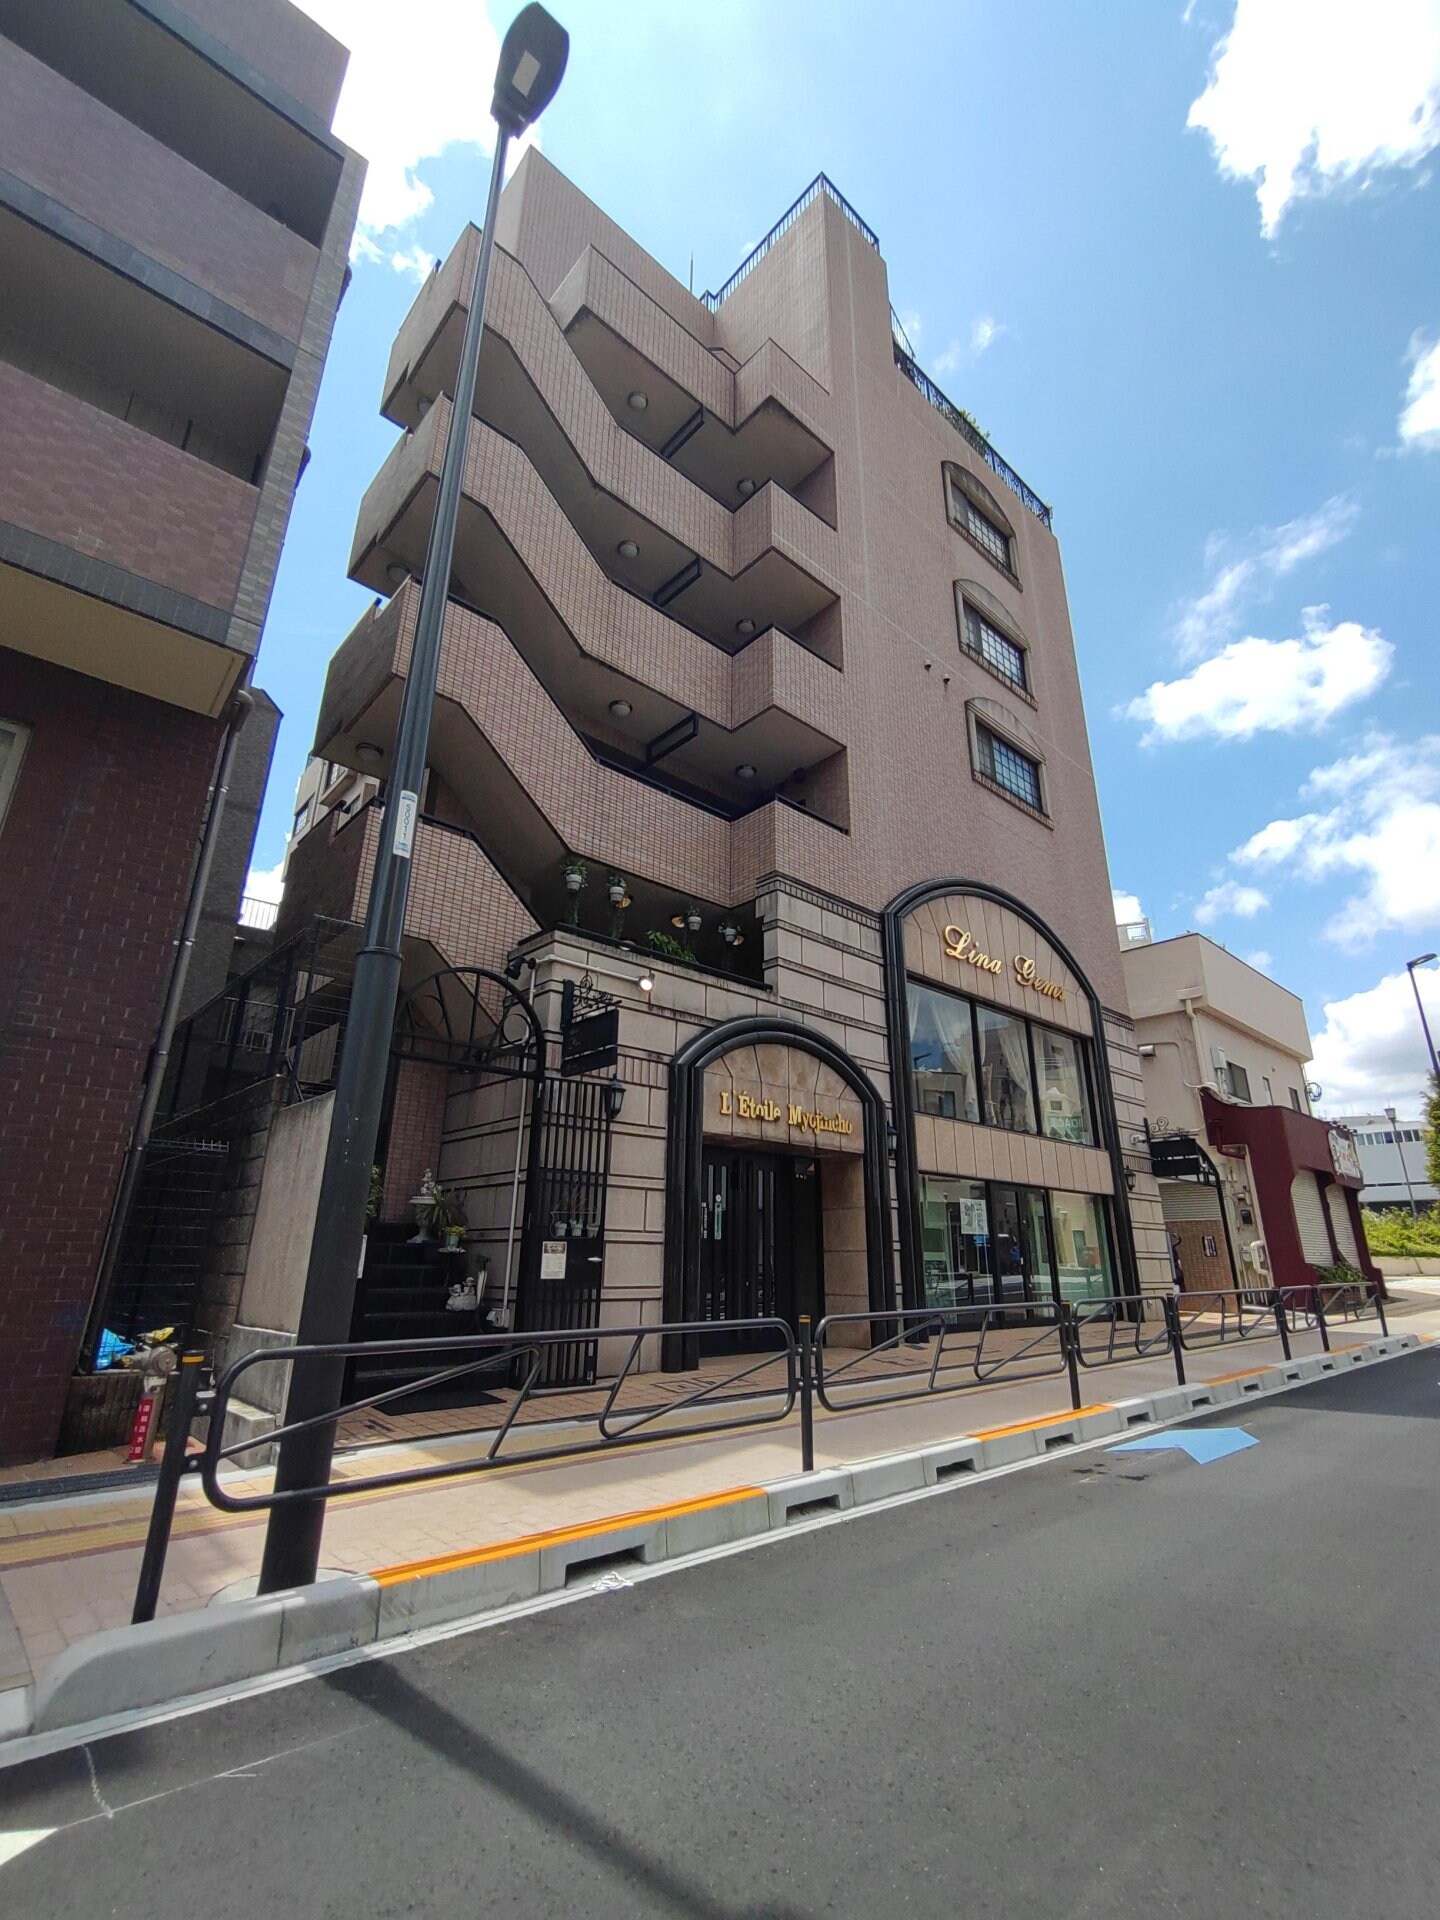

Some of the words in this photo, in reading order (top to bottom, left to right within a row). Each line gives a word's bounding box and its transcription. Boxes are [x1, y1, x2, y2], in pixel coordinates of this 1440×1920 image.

[945, 925, 1002, 974] Lina
[1014, 954, 1067, 1001] Gems
[787, 1103, 852, 1135] Myojincho
